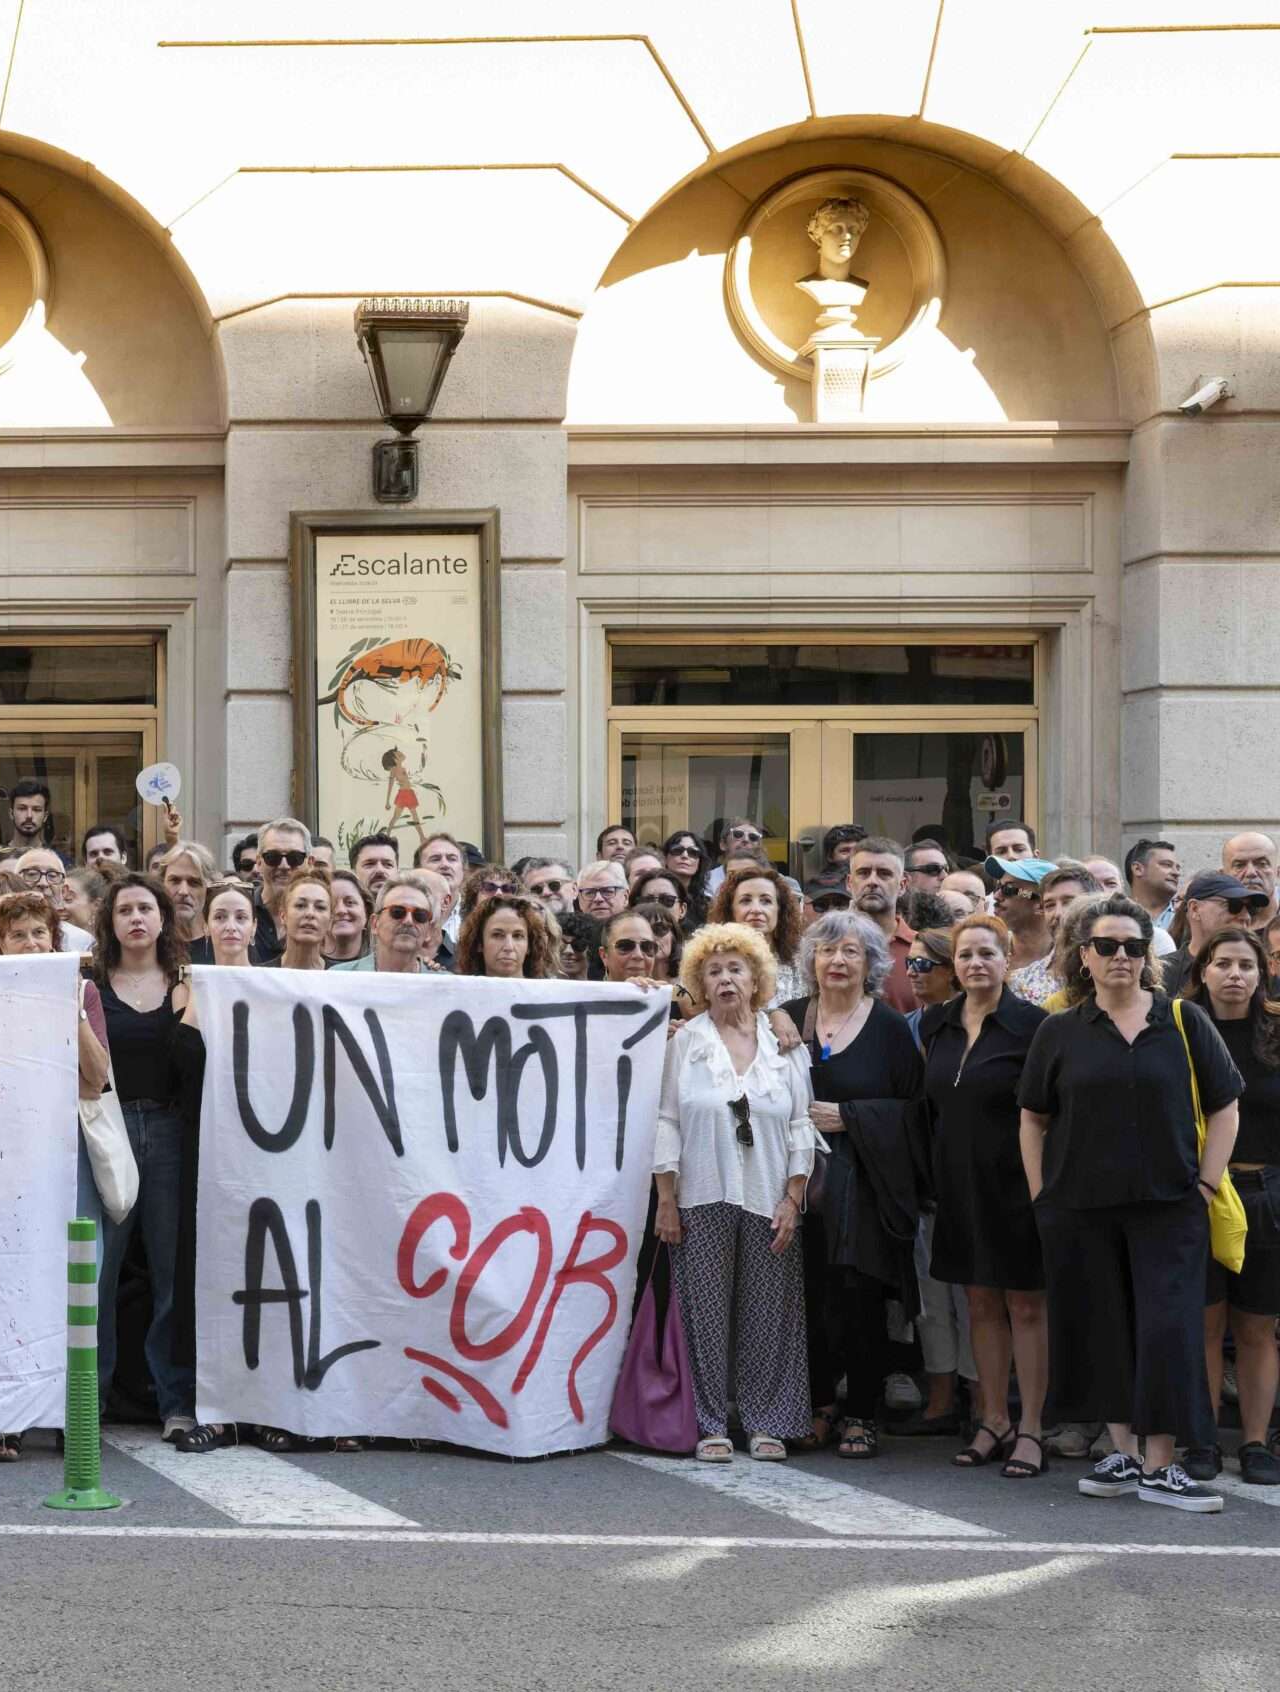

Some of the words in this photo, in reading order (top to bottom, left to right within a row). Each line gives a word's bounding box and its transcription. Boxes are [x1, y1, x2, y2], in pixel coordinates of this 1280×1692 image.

[233, 1001, 405, 1157] UN
[231, 1197, 382, 1392] AL
[397, 1192, 628, 1424] COR
